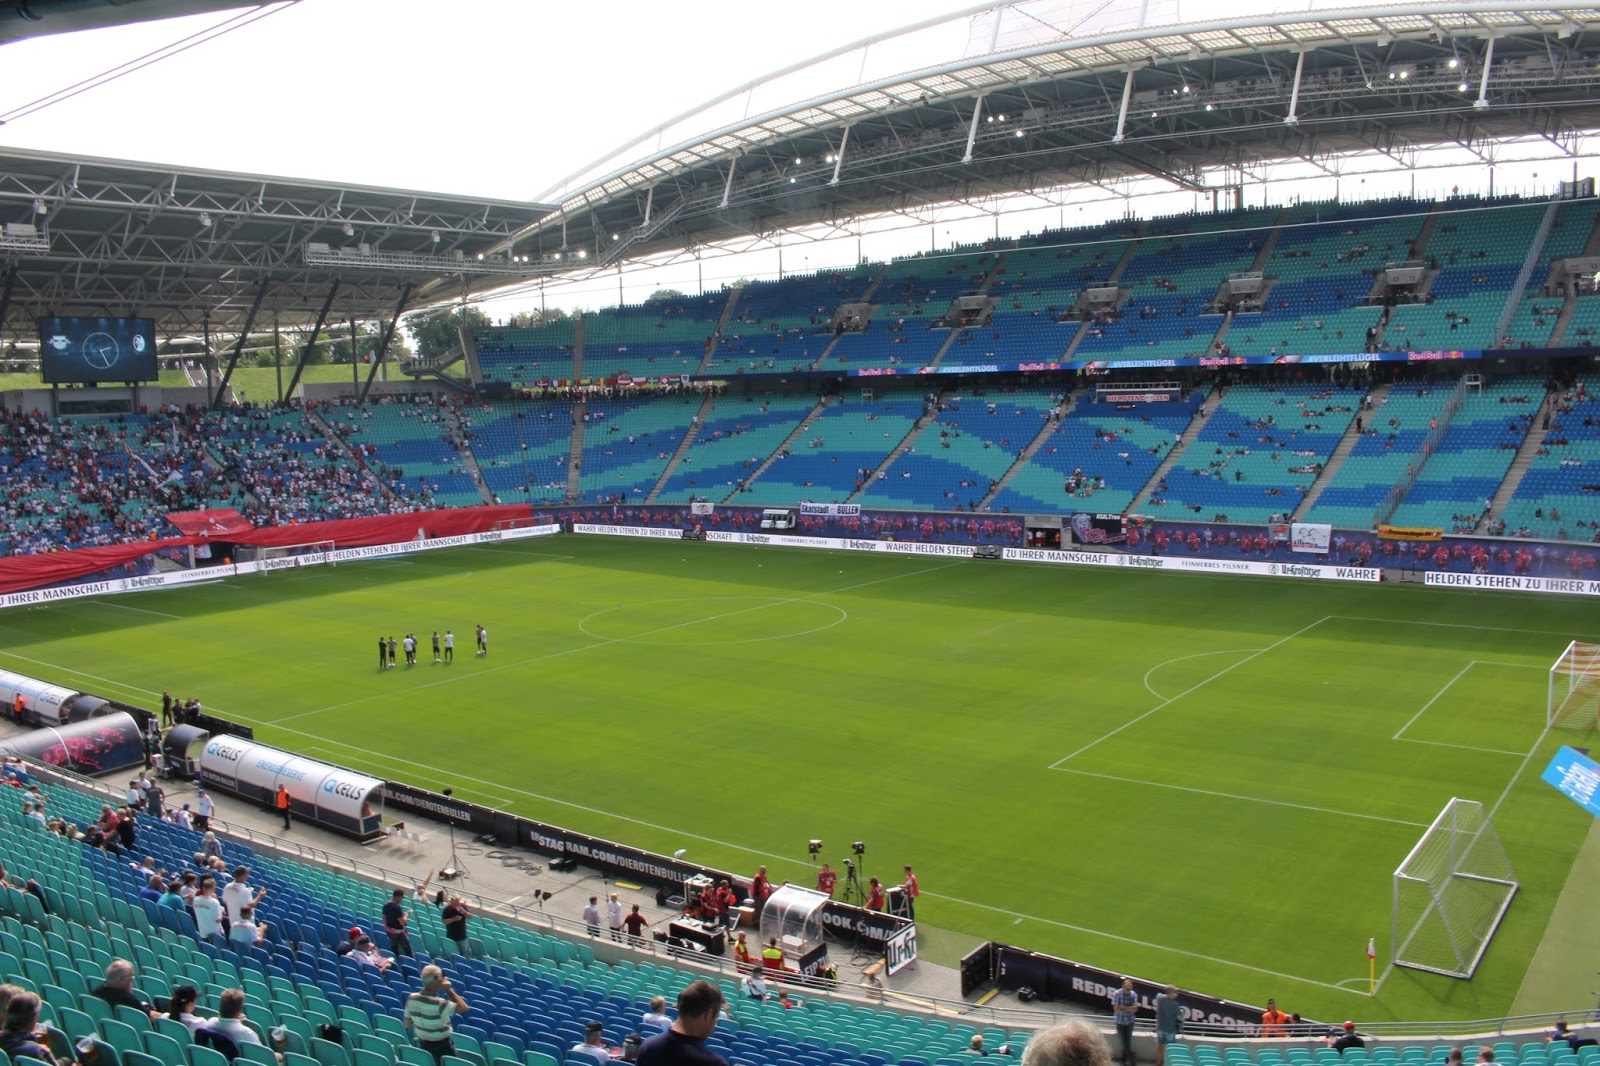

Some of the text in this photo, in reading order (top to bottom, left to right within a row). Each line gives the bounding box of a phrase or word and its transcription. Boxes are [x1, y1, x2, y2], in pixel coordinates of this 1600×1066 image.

[1408, 350, 1443, 360] Red Bull
[837, 504, 860, 515] BULLEN
[598, 526, 618, 534] HELDEN
[619, 527, 639, 535] STEHEN
[640, 528, 649, 536] ZU
[649, 529, 667, 537] IHRER
[886, 543, 914, 552] WAHRE
[916, 544, 945, 554] HELDEN
[947, 546, 976, 556] STEHEN
[1005, 549, 1017, 558] ZU
[1019, 550, 1045, 560] IHRER
[1047, 552, 1108, 564] MANNSCHAFT
[1181, 560, 1220, 569] FEINHERBES
[1222, 563, 1250, 571] PILSNER
[1336, 567, 1377, 580] WAHRE
[8, 592, 39, 605] IHRER
[43, 582, 110, 600] MANNSCHAFT
[303, 553, 331, 564] WAHRE
[334, 550, 361, 560] HELDEN
[362, 546, 389, 557] STEHEN
[390, 544, 400, 553] ZU
[423, 536, 467, 548] MANNSCHAFT
[1426, 572, 1472, 586] HELDEN
[1475, 575, 1521, 589] STEHEN
[1525, 578, 1541, 590] ZU
[1545, 579, 1585, 593] IHRER
[216, 745, 242, 762] CELLS
[335, 782, 366, 801] CELLS
